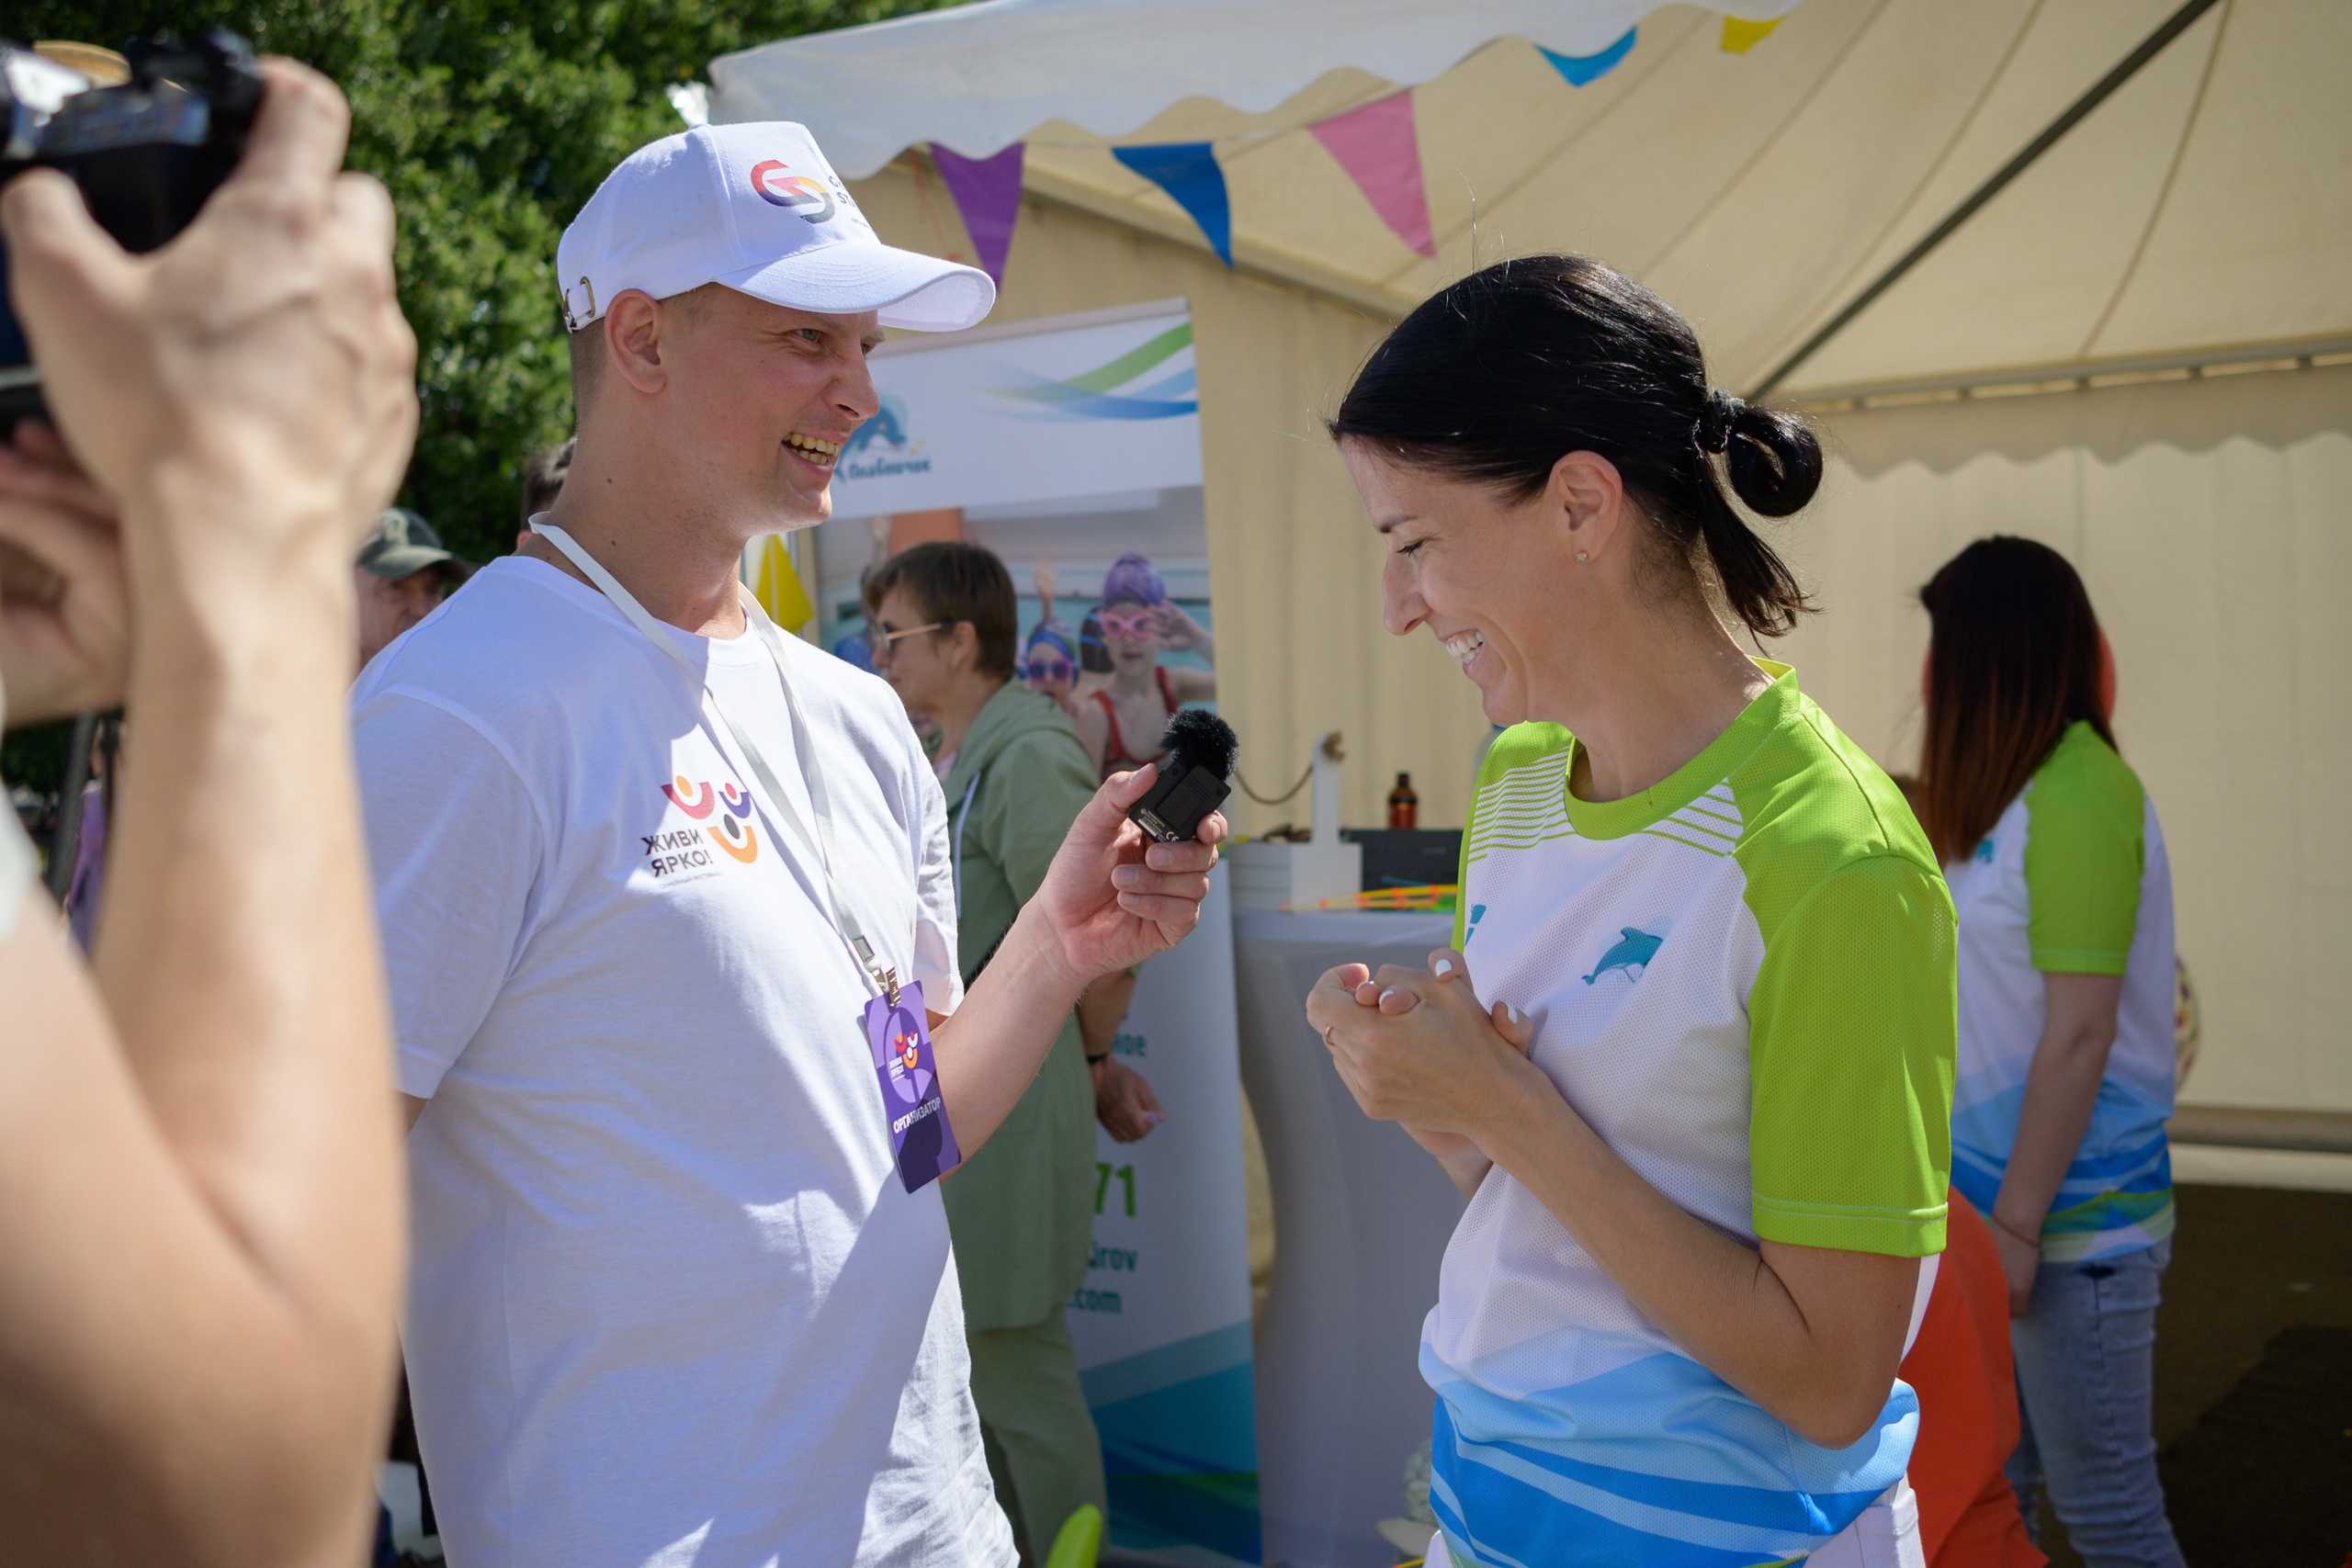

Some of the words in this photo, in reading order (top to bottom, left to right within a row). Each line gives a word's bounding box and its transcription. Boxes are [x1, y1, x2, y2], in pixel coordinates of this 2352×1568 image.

[640, 829, 704, 855] ЖИВИ
[651, 850, 714, 877] ЯРКО!
[893, 1096, 942, 1134] ОРГАНИЗАТОР
